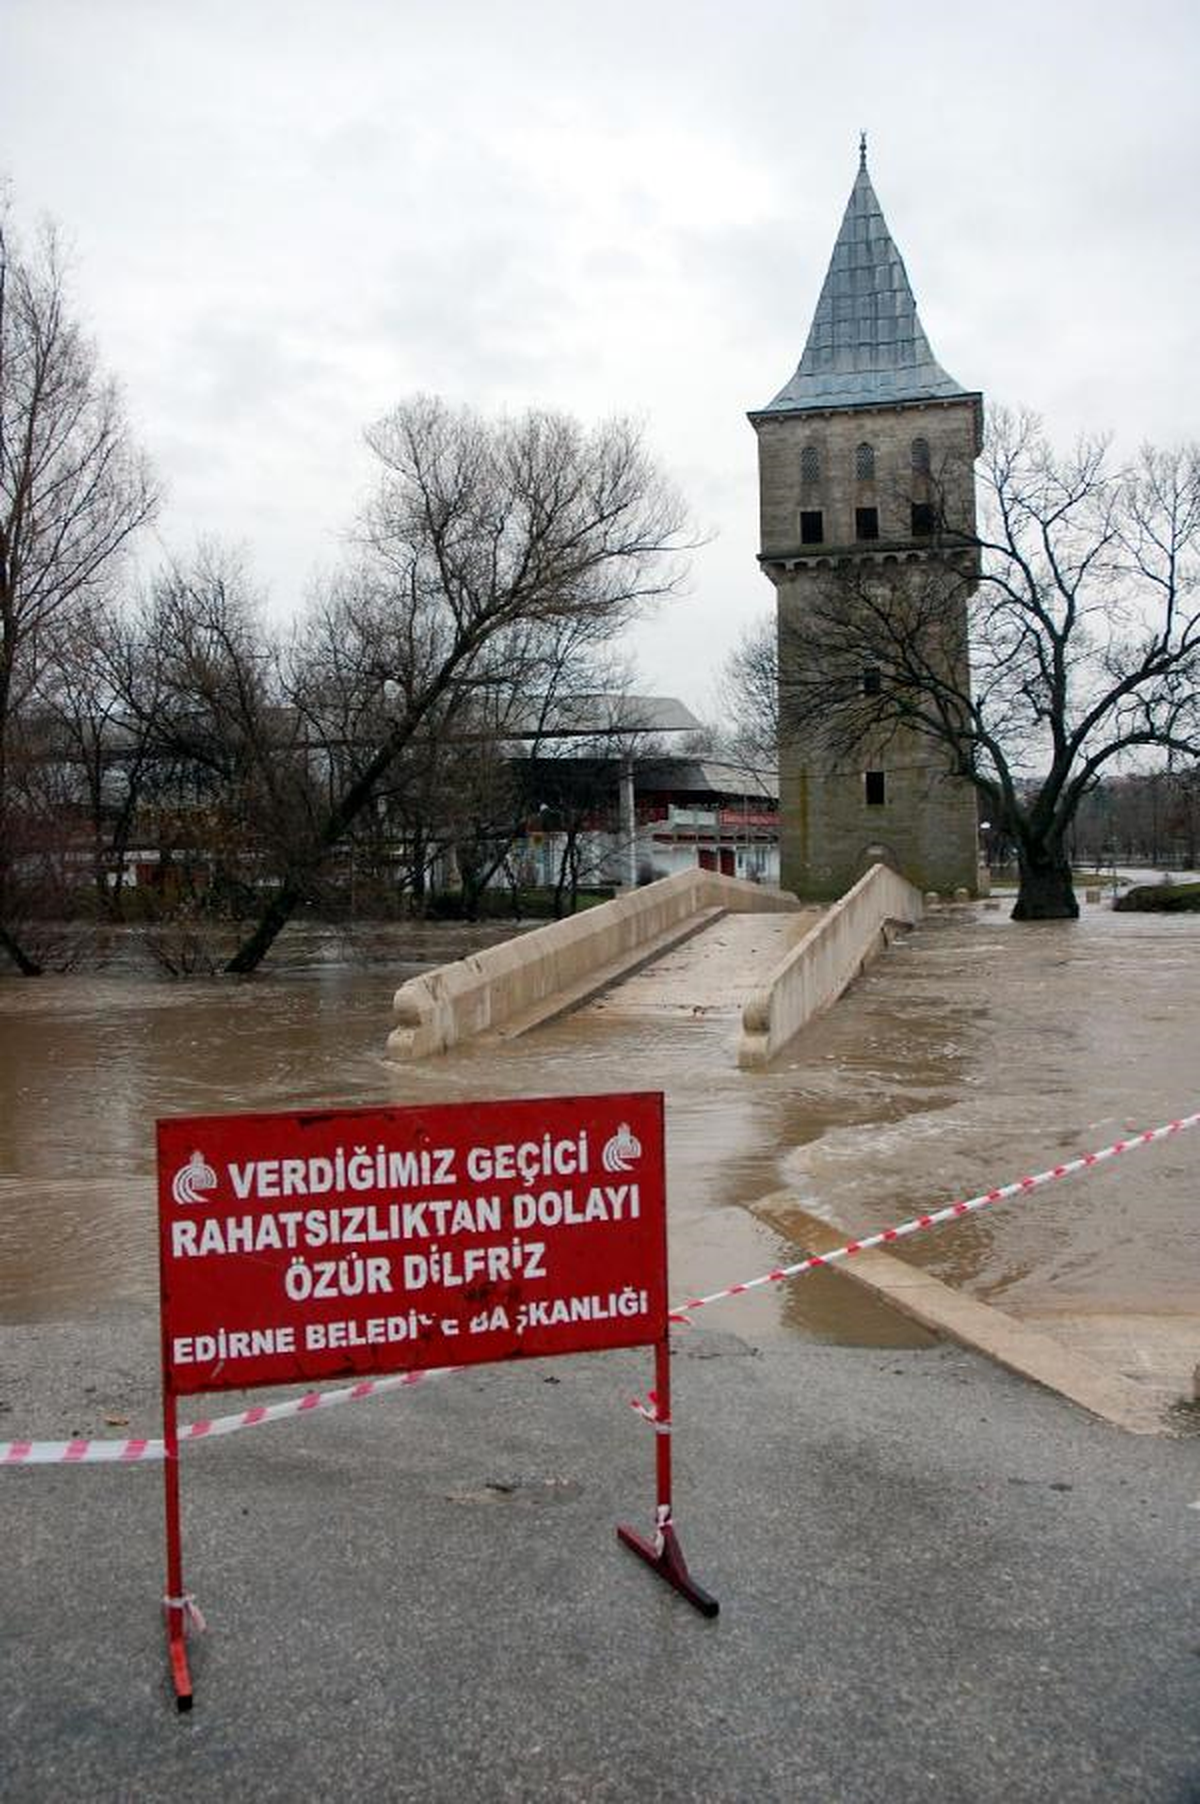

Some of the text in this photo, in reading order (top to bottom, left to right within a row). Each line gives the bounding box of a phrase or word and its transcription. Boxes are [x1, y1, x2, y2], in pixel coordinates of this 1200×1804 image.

[467, 1131, 588, 1187] GEÇİCİ
[172, 1184, 640, 1258] RAHATSIZLIKTAN DOLAYI
[285, 1252, 393, 1301] ÖZÜR
[173, 1326, 296, 1365] EDİRNE
